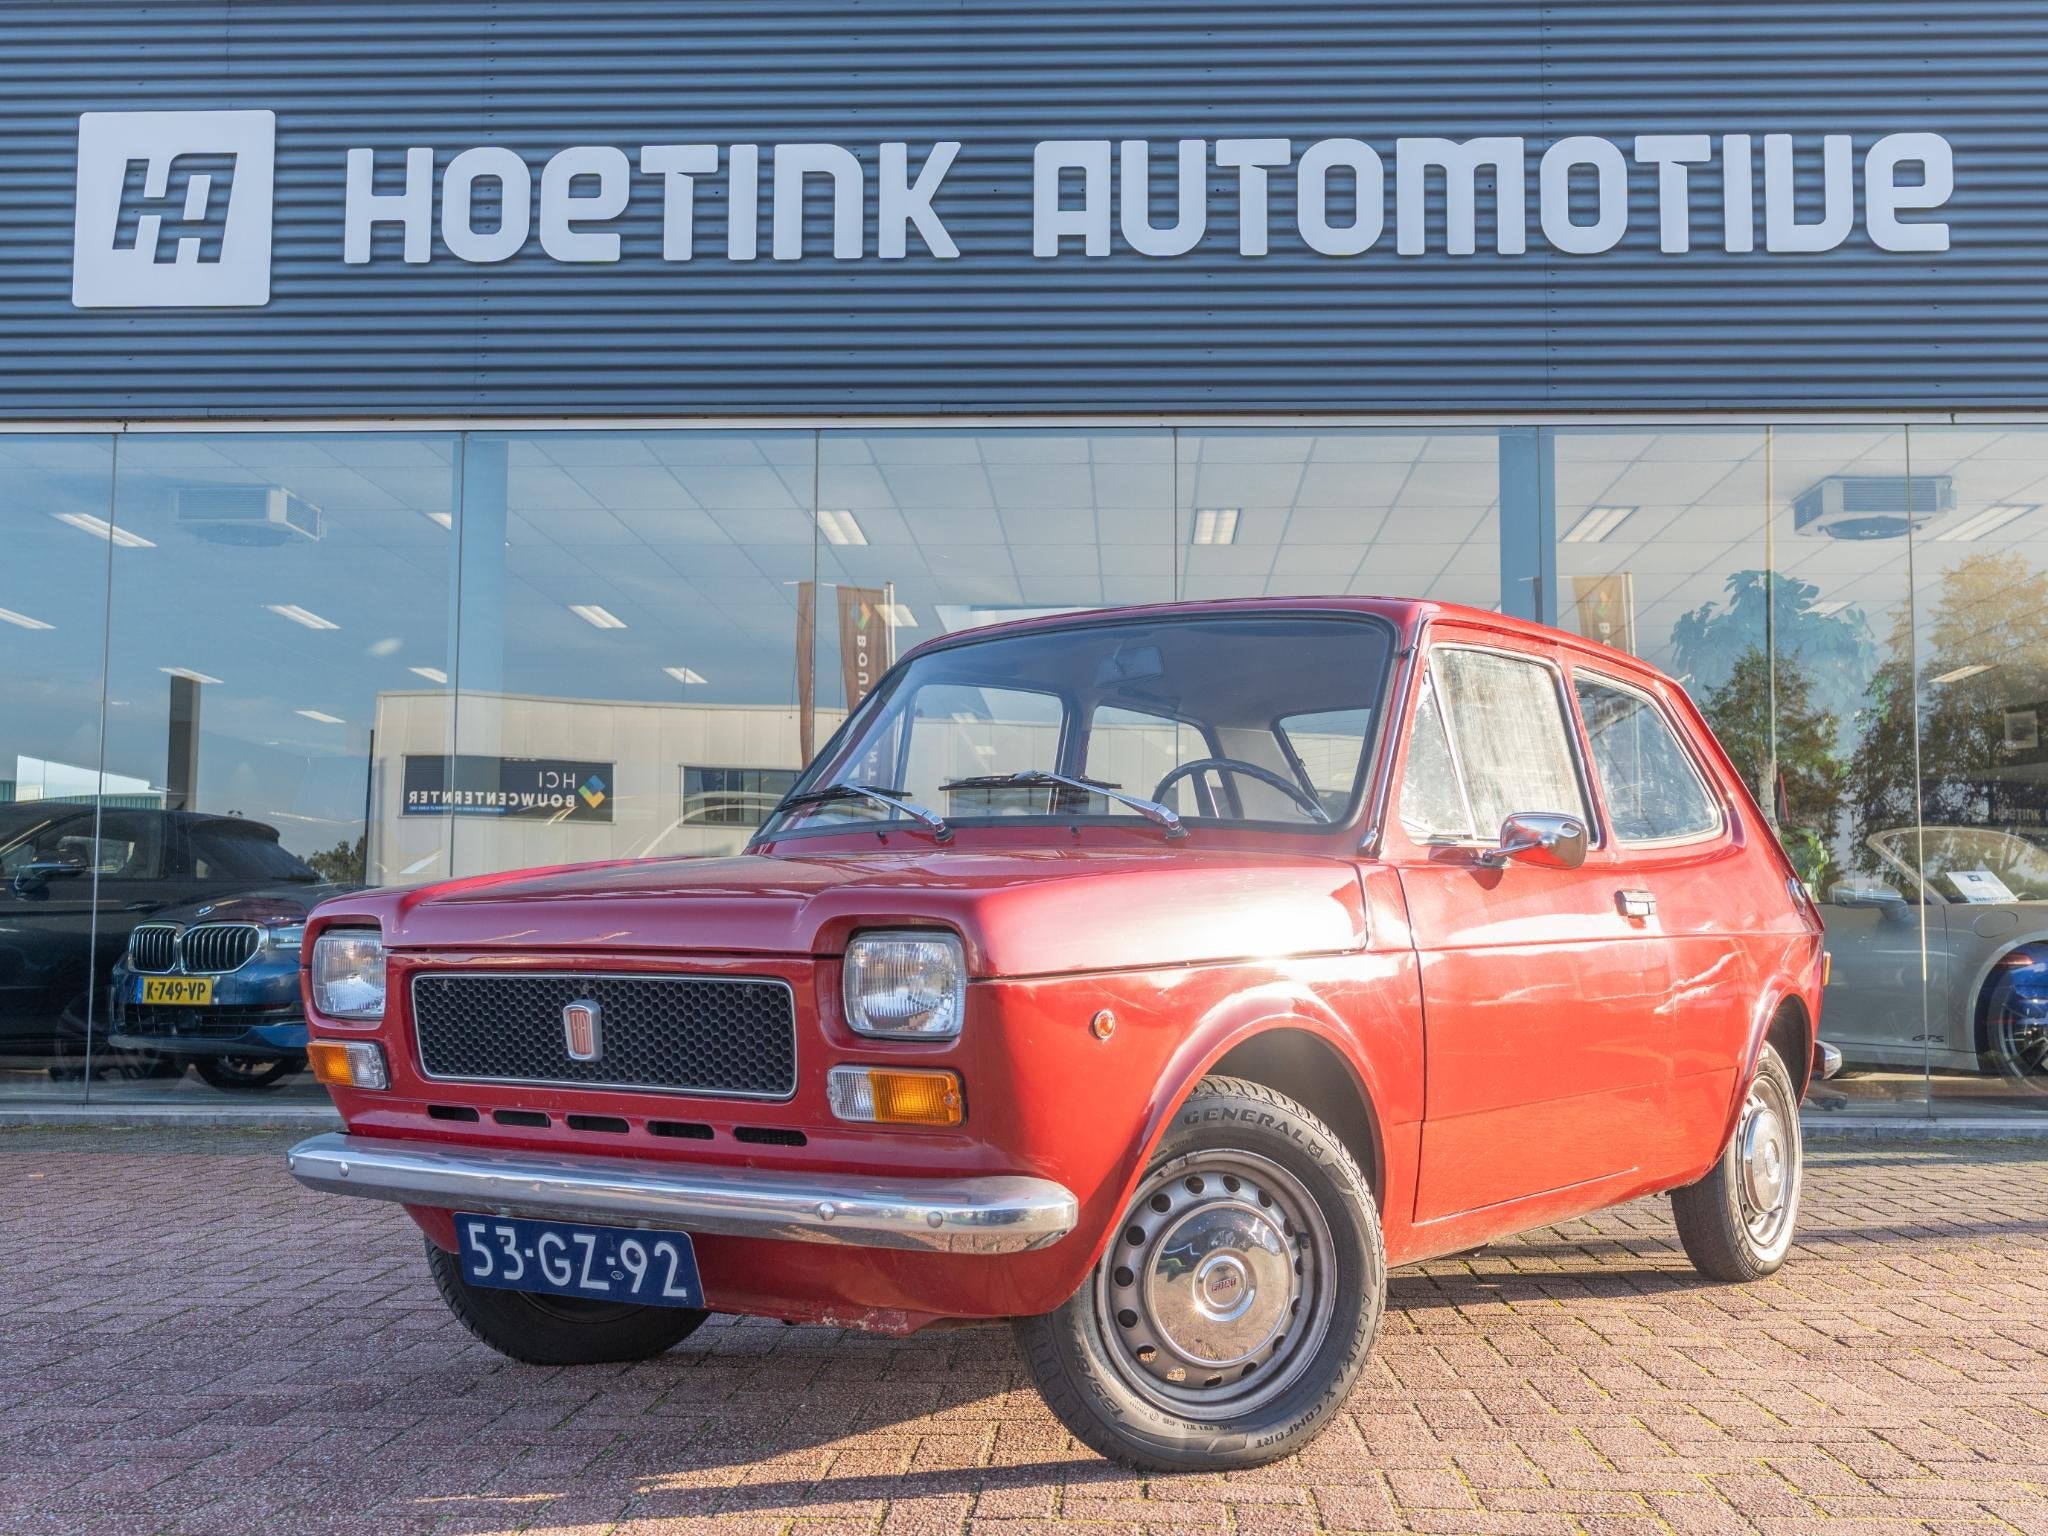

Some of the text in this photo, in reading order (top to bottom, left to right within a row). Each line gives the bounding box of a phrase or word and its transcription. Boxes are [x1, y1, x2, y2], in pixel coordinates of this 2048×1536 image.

[343, 132, 1955, 264] HOETINK AUTOMOTIVE
[145, 981, 206, 1001] K-749-VP
[1183, 1107, 1304, 1145] GENERAL
[467, 1222, 688, 1298] 53-GZ-92
